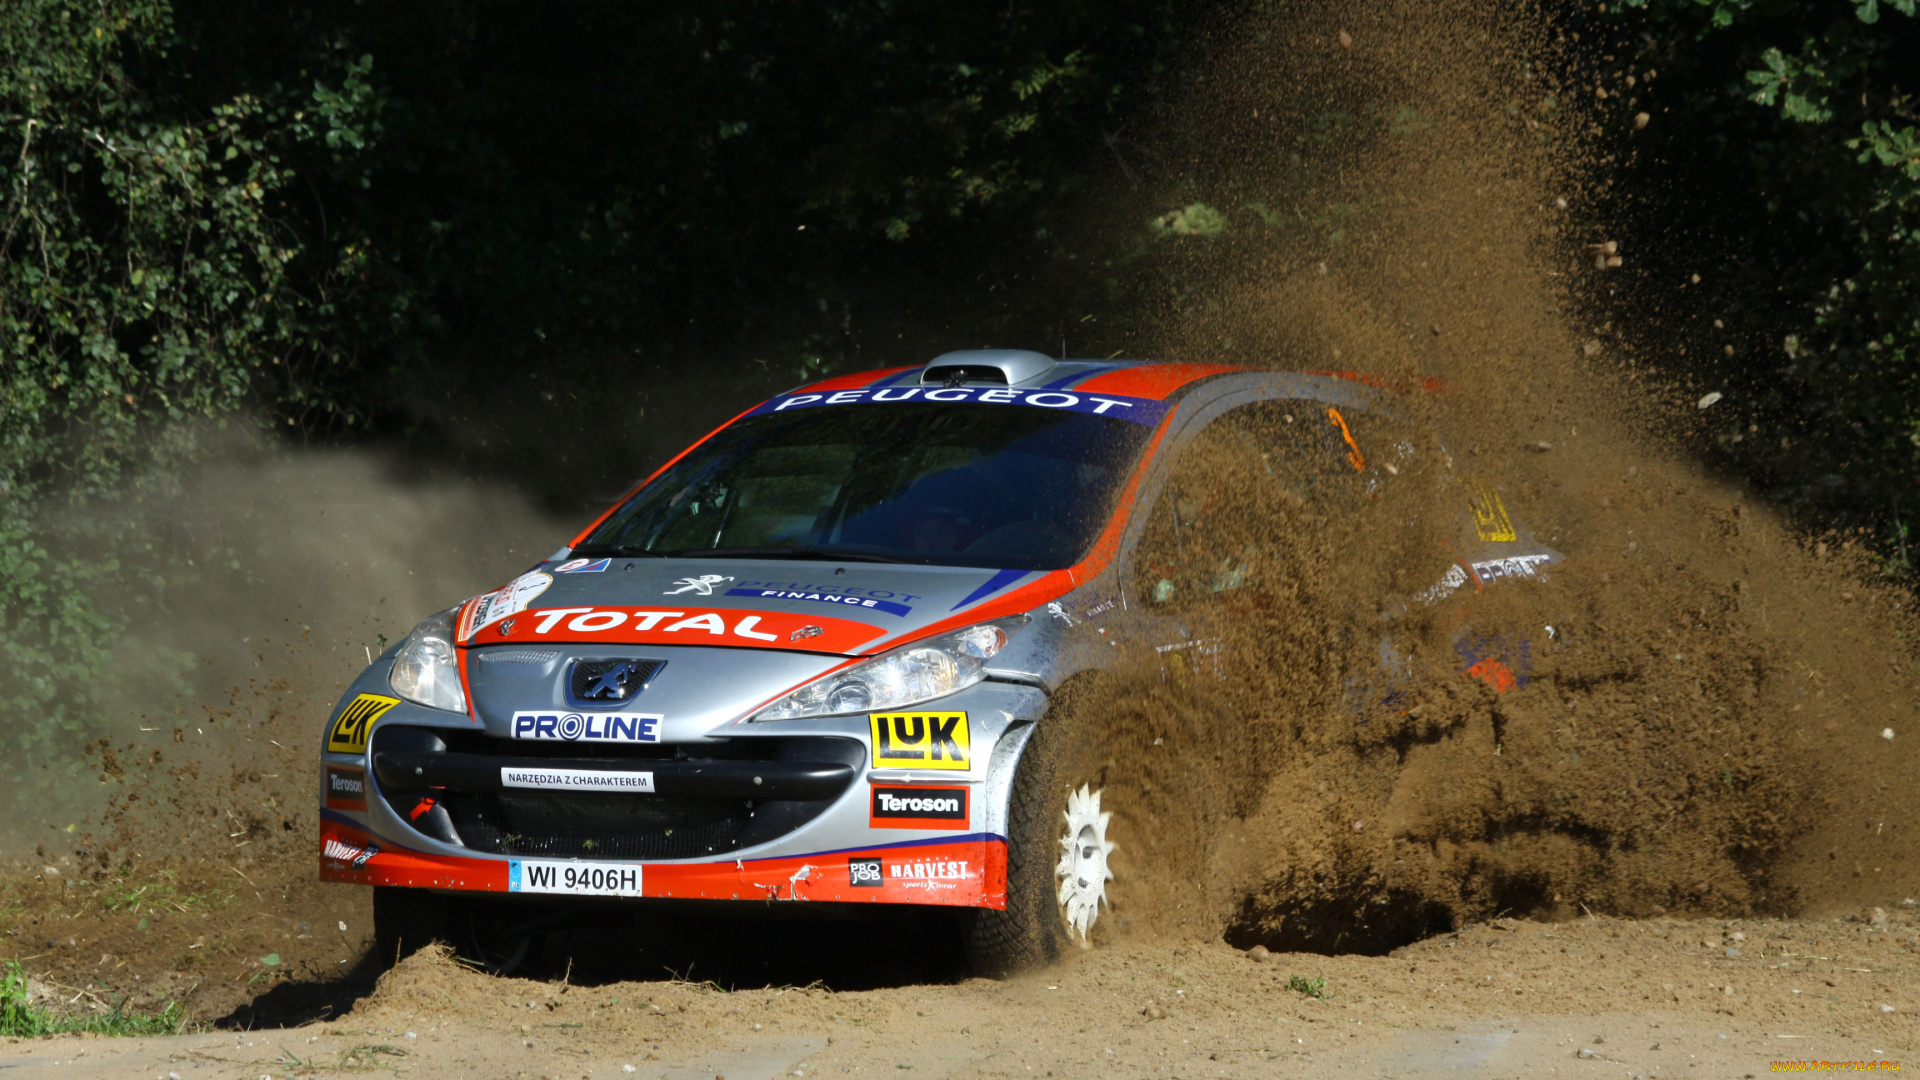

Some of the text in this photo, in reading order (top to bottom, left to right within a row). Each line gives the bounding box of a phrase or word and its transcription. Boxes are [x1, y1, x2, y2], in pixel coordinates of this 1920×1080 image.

[774, 388, 1132, 414] PEUGEOT
[736, 580, 922, 604] PEUGEOT
[760, 590, 878, 608] FINANCE
[533, 607, 778, 643] TOTAL
[515, 713, 658, 742] PROLINE
[876, 716, 965, 762] LUK
[330, 773, 363, 793] Teroson
[508, 773, 648, 787] NARZĘDZIA Z CHARAKTEREM
[878, 793, 959, 812] Teroson
[528, 866, 636, 891] WI 9406H
[850, 864, 880, 874] PRO
[851, 873, 881, 885] JOB
[891, 862, 967, 880] HARVEST
